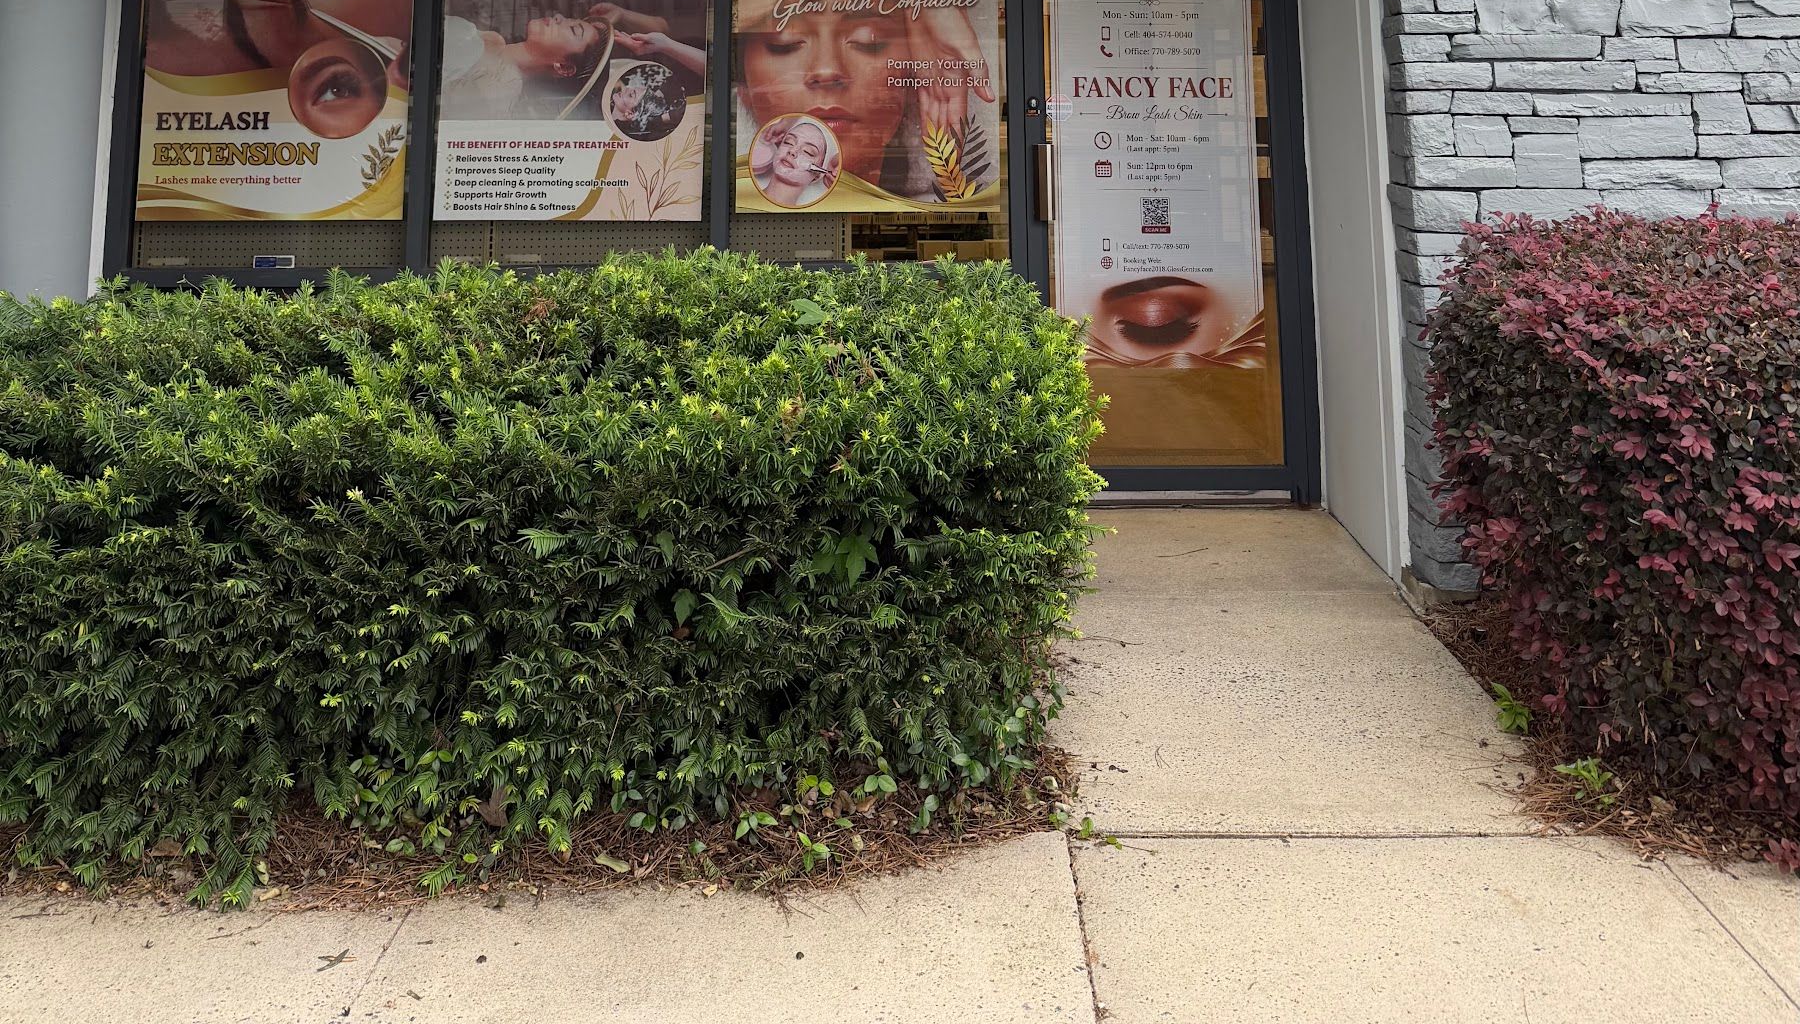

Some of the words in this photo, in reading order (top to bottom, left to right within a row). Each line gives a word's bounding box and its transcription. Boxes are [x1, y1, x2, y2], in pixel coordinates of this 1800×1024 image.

[1102, 10, 1122, 19] Mon
[1129, 10, 1149, 19] Sun:
[1151, 10, 1173, 19] 10am
[1181, 10, 1200, 21] 5pm
[1124, 30, 1141, 39] Cell:
[1142, 30, 1193, 39] 404-574-0040
[1124, 47, 1150, 56] Office:
[1151, 47, 1201, 56] 770-789-5070
[887, 59, 934, 72] Pamper
[936, 58, 985, 71] Yourself
[887, 76, 934, 89] Pamper
[936, 76, 964, 88] Your
[966, 75, 990, 88] Skin
[1072, 76, 1160, 98] FANCY
[1168, 77, 1234, 99] FACE
[1106, 104, 1141, 120] Brow
[1142, 104, 1173, 124] Lash
[1173, 104, 1203, 121] Skin
[155, 111, 271, 131] EYELASH
[1126, 134, 1144, 143] Mon
[1150, 134, 1165, 143] Sat:
[1167, 134, 1186, 143] 10am
[1193, 134, 1210, 144] 6pm
[447, 141, 466, 149] THE
[467, 141, 507, 149] BENEFIT
[509, 141, 523, 149] OF
[524, 141, 551, 149] HEAD
[552, 141, 571, 149] SPA
[572, 141, 630, 149] TREATMENT
[1126, 145, 1143, 154] (Last
[1163, 145, 1180, 154] 5pm)
[152, 141, 321, 166] EXTENSION
[456, 154, 492, 163] Relieves
[494, 154, 521, 163] Stress
[523, 154, 529, 163] &
[530, 154, 565, 165] Anxiety
[455, 167, 497, 176] Improves
[498, 166, 522, 176] Sleep
[524, 166, 556, 176] Quality
[1127, 162, 1144, 170] Sun:
[1145, 162, 1166, 172] 12pm
[1176, 162, 1193, 172] 6pm
[155, 175, 188, 185] Lashes
[191, 175, 217, 185] make
[219, 175, 271, 186] everything
[273, 175, 302, 184] better
[1127, 173, 1144, 182] (Last
[454, 179, 478, 188] Deep
[478, 178, 517, 188] cleaning
[518, 179, 526, 187] &
[527, 179, 574, 189] promoting
[575, 179, 600, 189] scalp
[600, 178, 630, 187] health
[453, 191, 494, 201] Supports
[495, 190, 514, 199] Hair
[515, 190, 547, 199] Growth
[453, 203, 483, 211] Boosts
[484, 203, 503, 211] Hair
[503, 203, 529, 211] Shine
[530, 203, 537, 211] &
[538, 203, 577, 211] Softness
[1123, 257, 1147, 265] Booking
